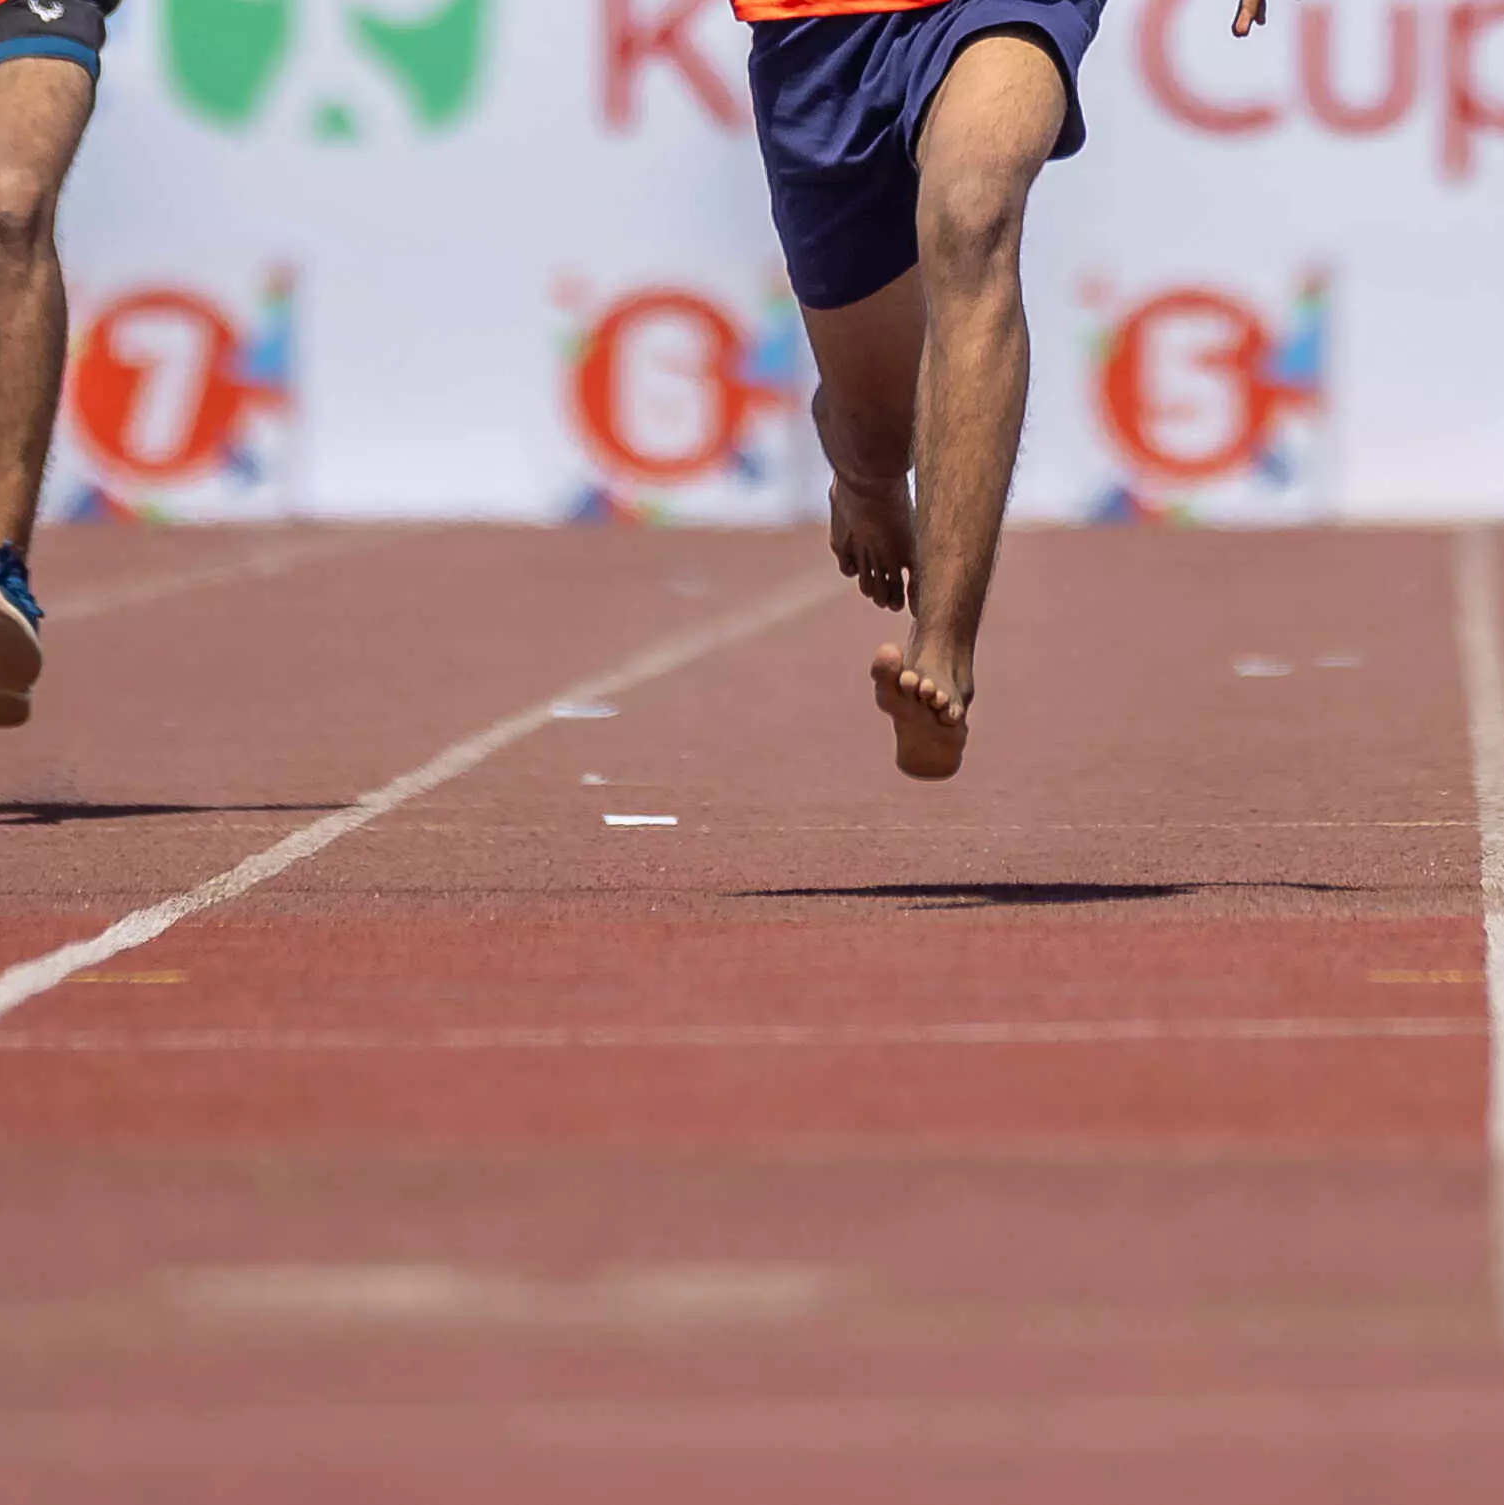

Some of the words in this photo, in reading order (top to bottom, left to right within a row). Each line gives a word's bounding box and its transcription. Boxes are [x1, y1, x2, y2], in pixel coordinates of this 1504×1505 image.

[110, 310, 209, 463] 7
[616, 311, 716, 461] 6
[1141, 310, 1243, 461] 5
